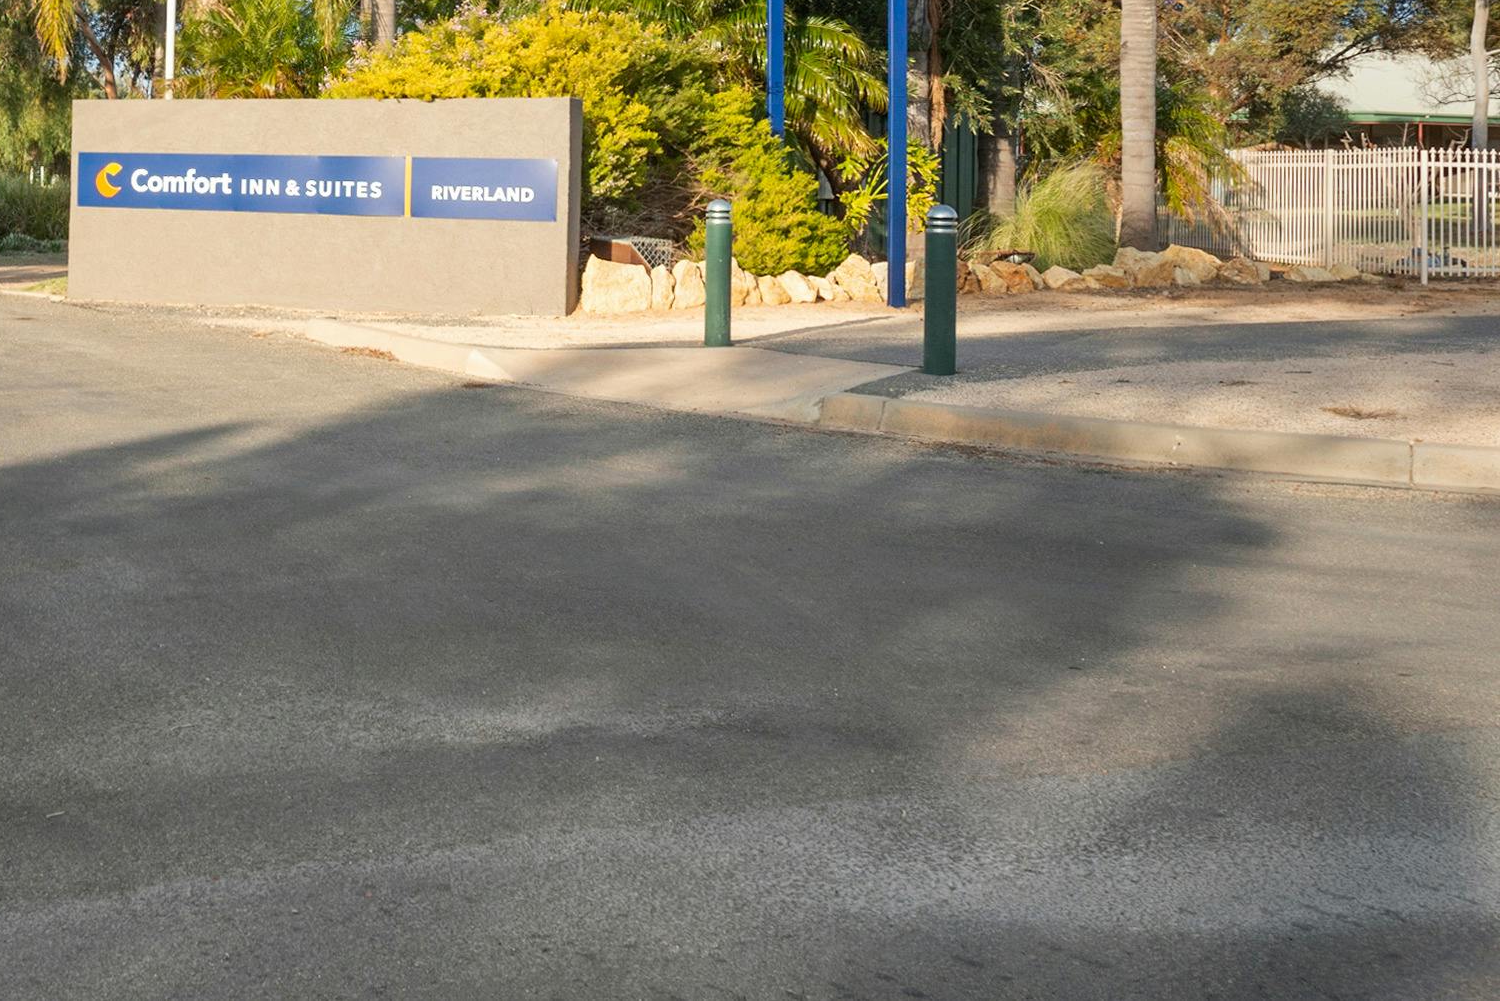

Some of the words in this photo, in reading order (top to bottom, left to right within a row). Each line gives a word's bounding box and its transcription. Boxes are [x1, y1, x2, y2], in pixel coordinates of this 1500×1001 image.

[130, 168, 233, 195] Comfort
[240, 178, 281, 196] INN
[284, 179, 300, 197] &
[305, 179, 383, 199] SUITES
[431, 185, 536, 203] RIVERLAND
